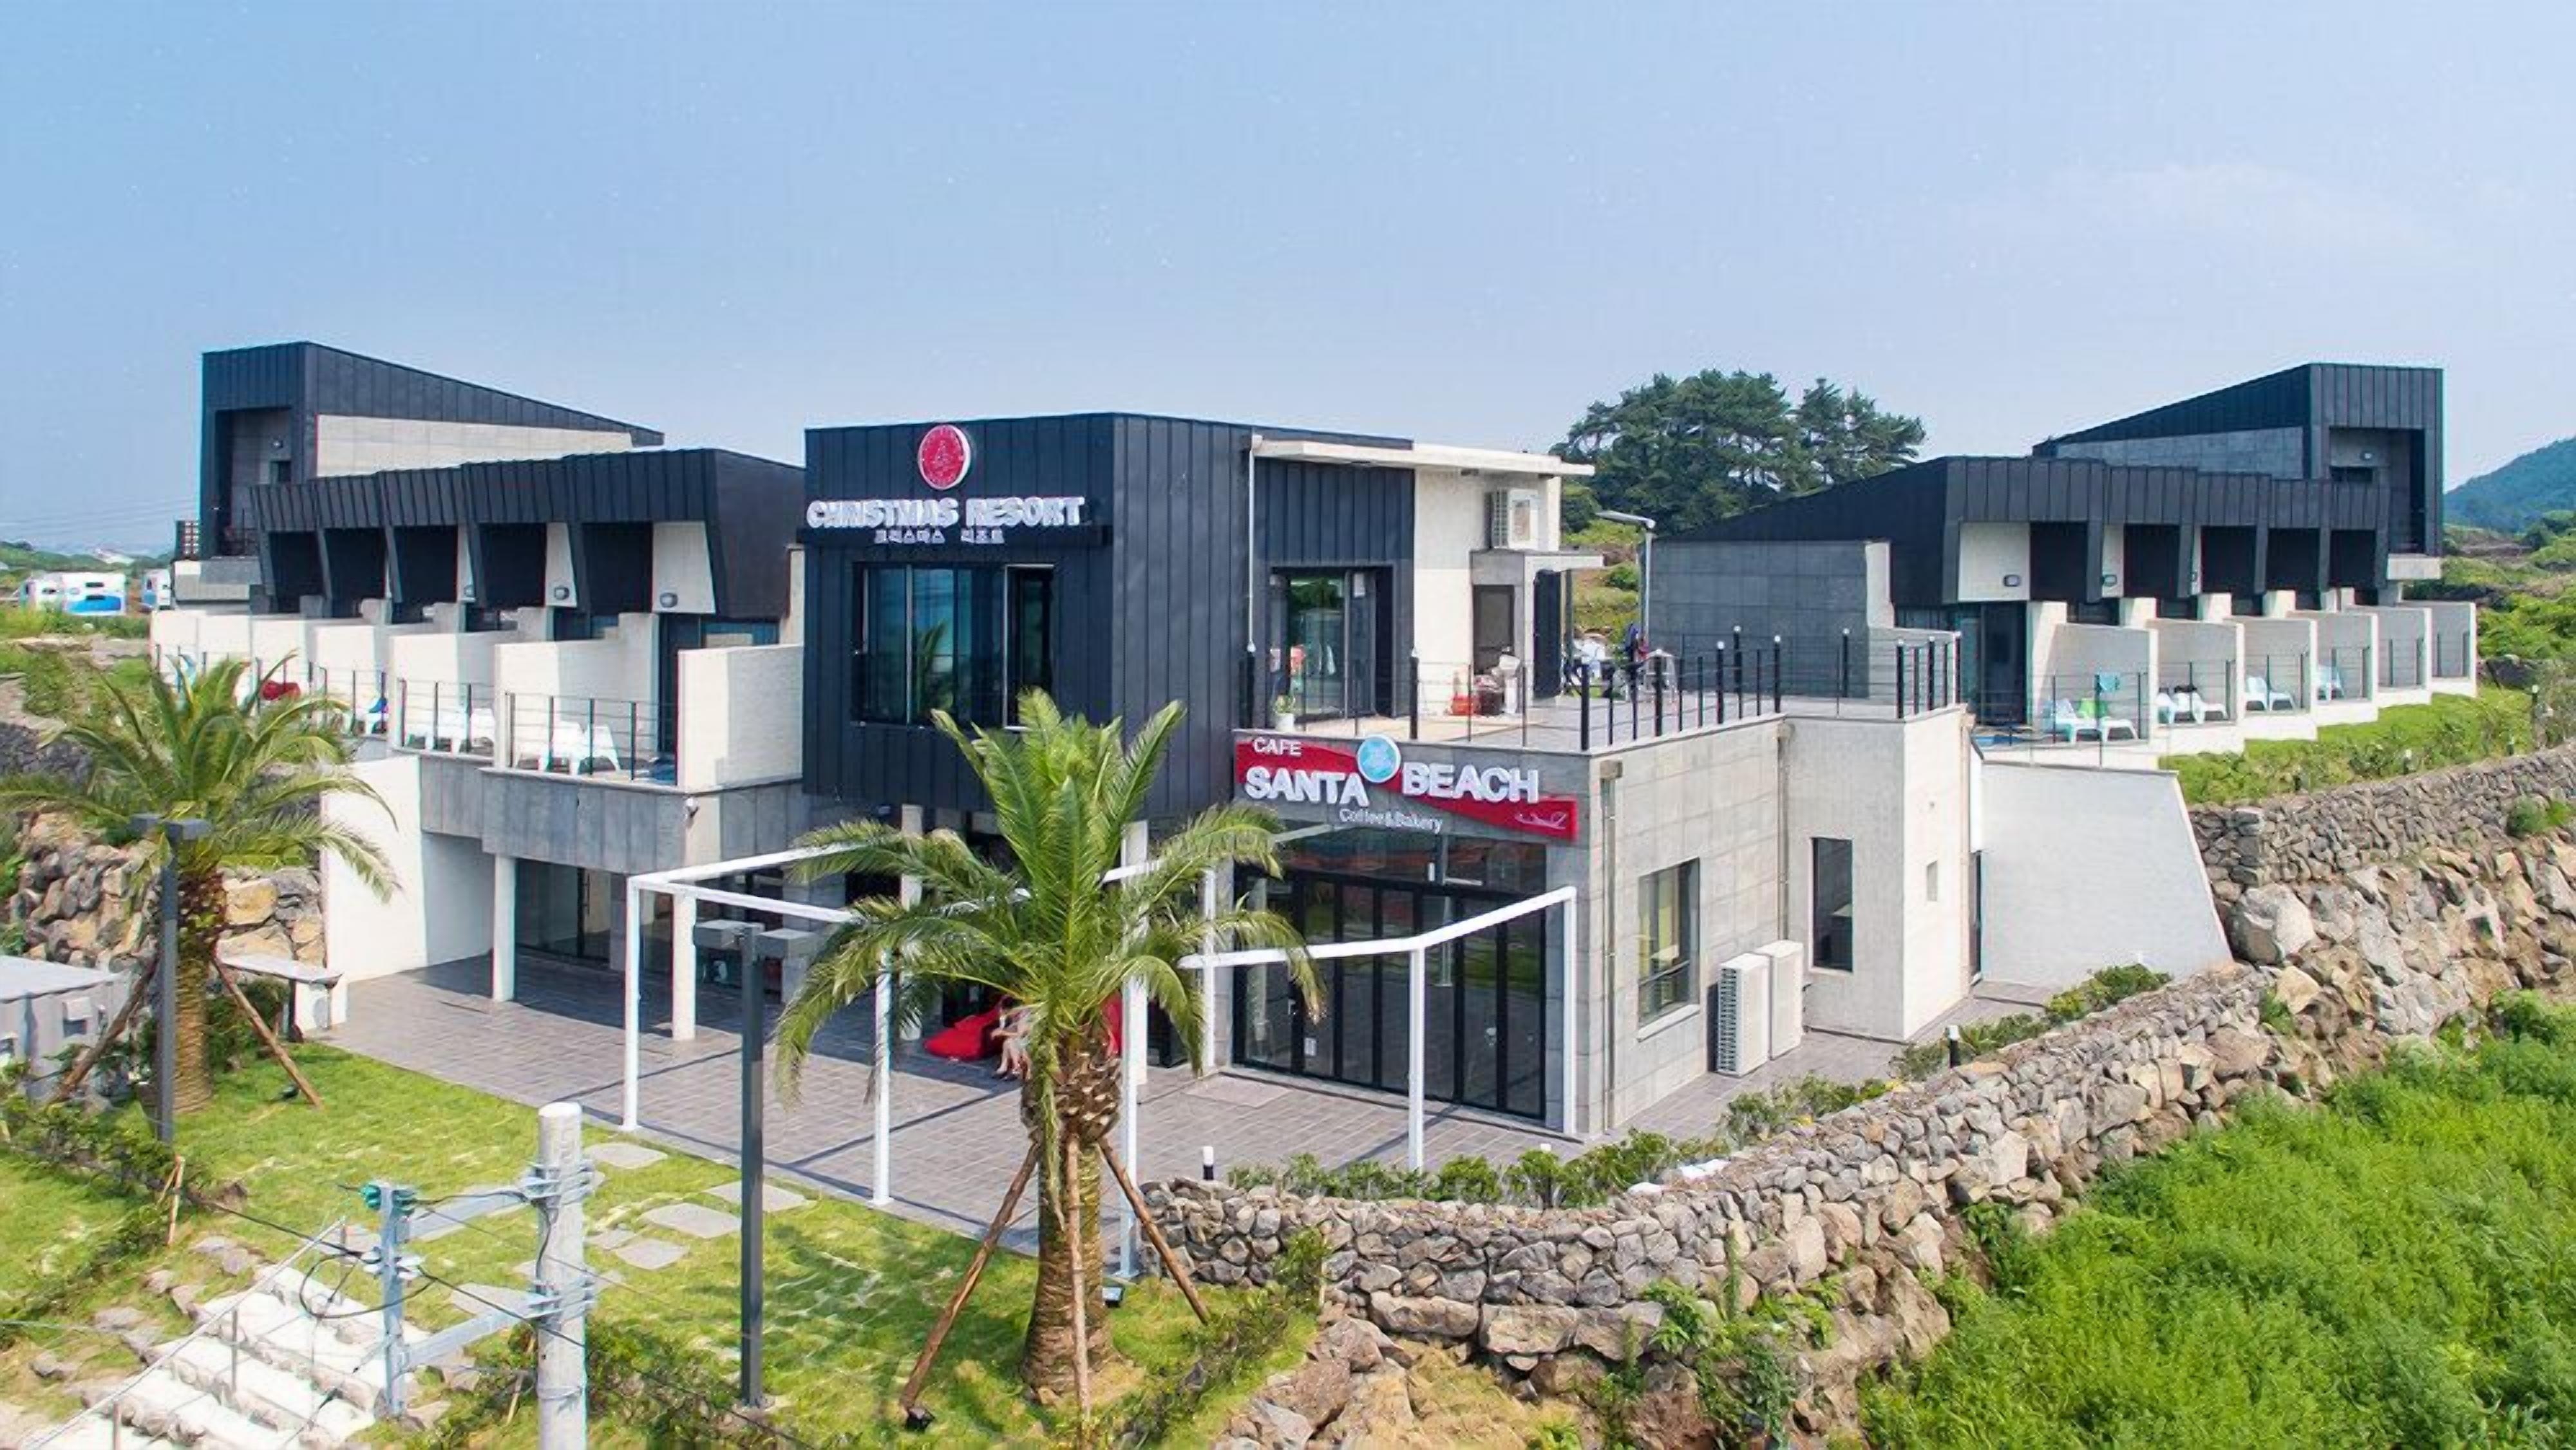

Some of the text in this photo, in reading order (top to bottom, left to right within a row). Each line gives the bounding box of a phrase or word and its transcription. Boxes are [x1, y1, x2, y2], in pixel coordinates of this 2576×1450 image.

[966, 496, 1085, 527] RESORT
[1253, 737, 1302, 757] CAFE
[1245, 762, 1540, 807] SANTA BEACH
